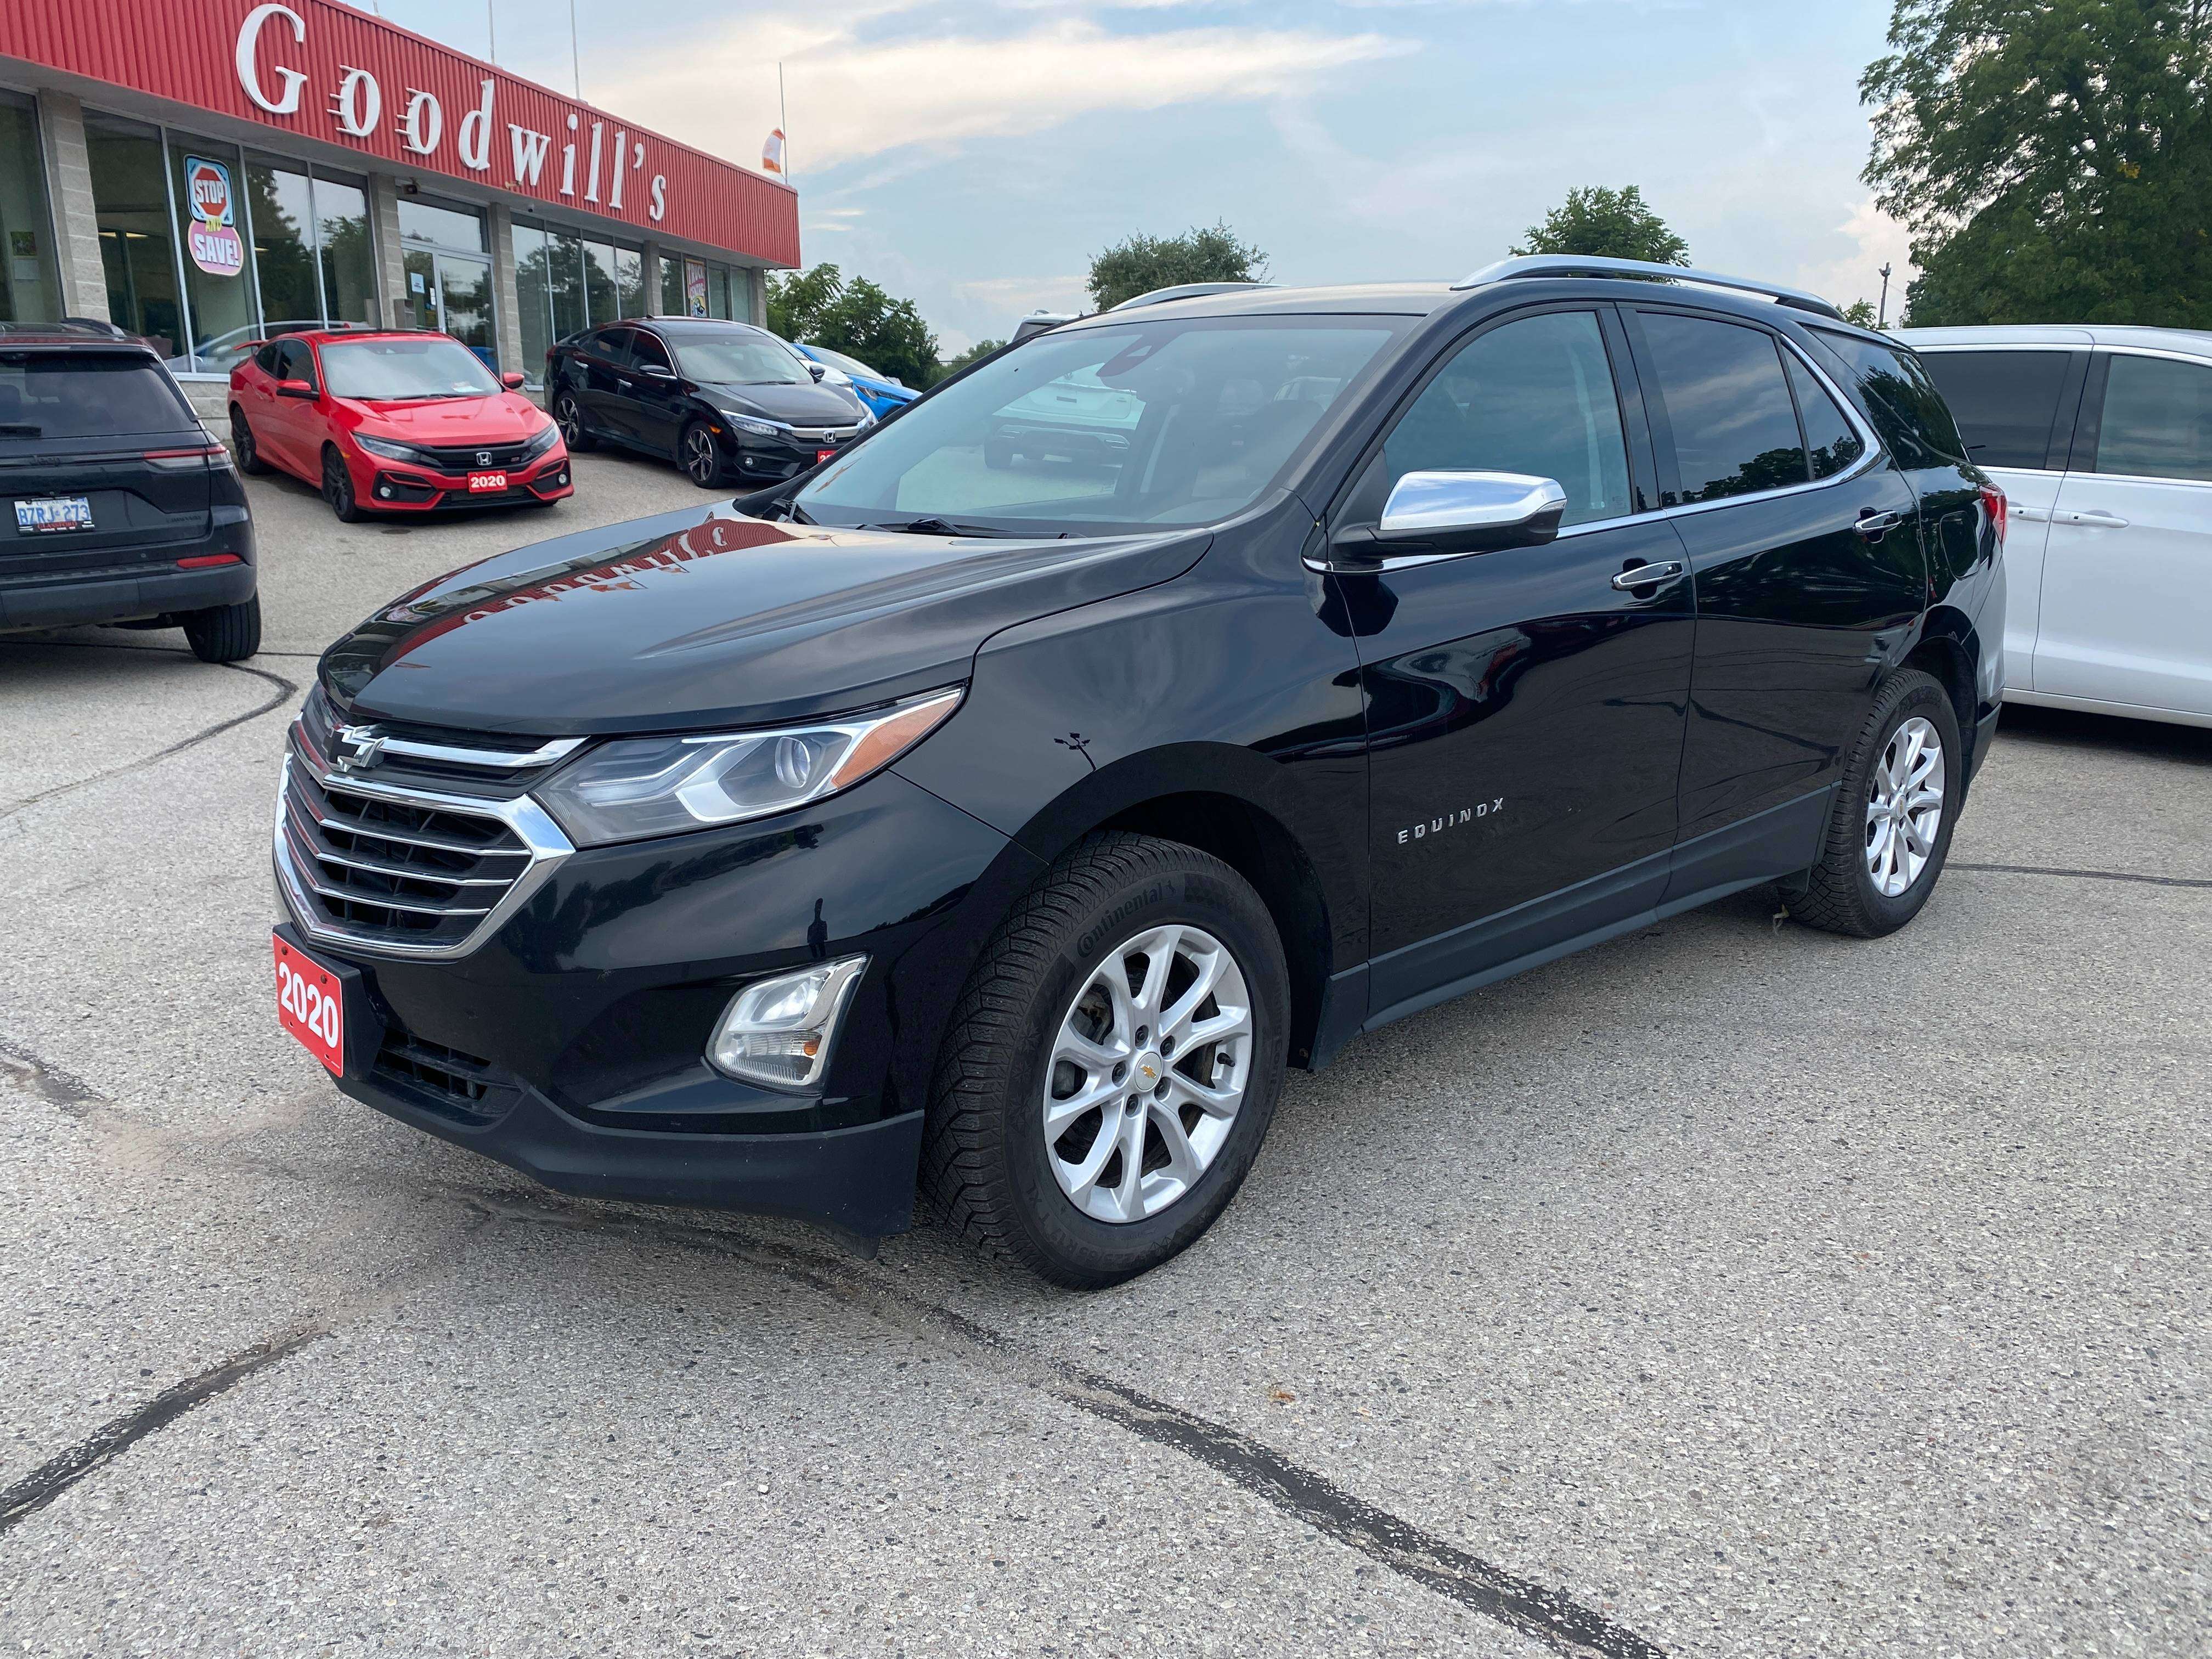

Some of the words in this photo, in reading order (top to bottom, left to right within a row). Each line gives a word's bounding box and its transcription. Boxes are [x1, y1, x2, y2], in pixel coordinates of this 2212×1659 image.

[236, 3, 666, 221] Goodwill's
[195, 179, 224, 204] STOP
[205, 219, 222, 232] AND
[194, 233, 240, 267] SAVE!
[687, 263, 705, 285] TRUCK
[690, 283, 706, 301] CENTRE
[470, 475, 505, 488] 2020
[63, 504, 89, 521] 273
[1397, 798, 1504, 844] EQUINOX
[1077, 882, 1163, 958] Continental
[279, 962, 338, 1048] 2020
